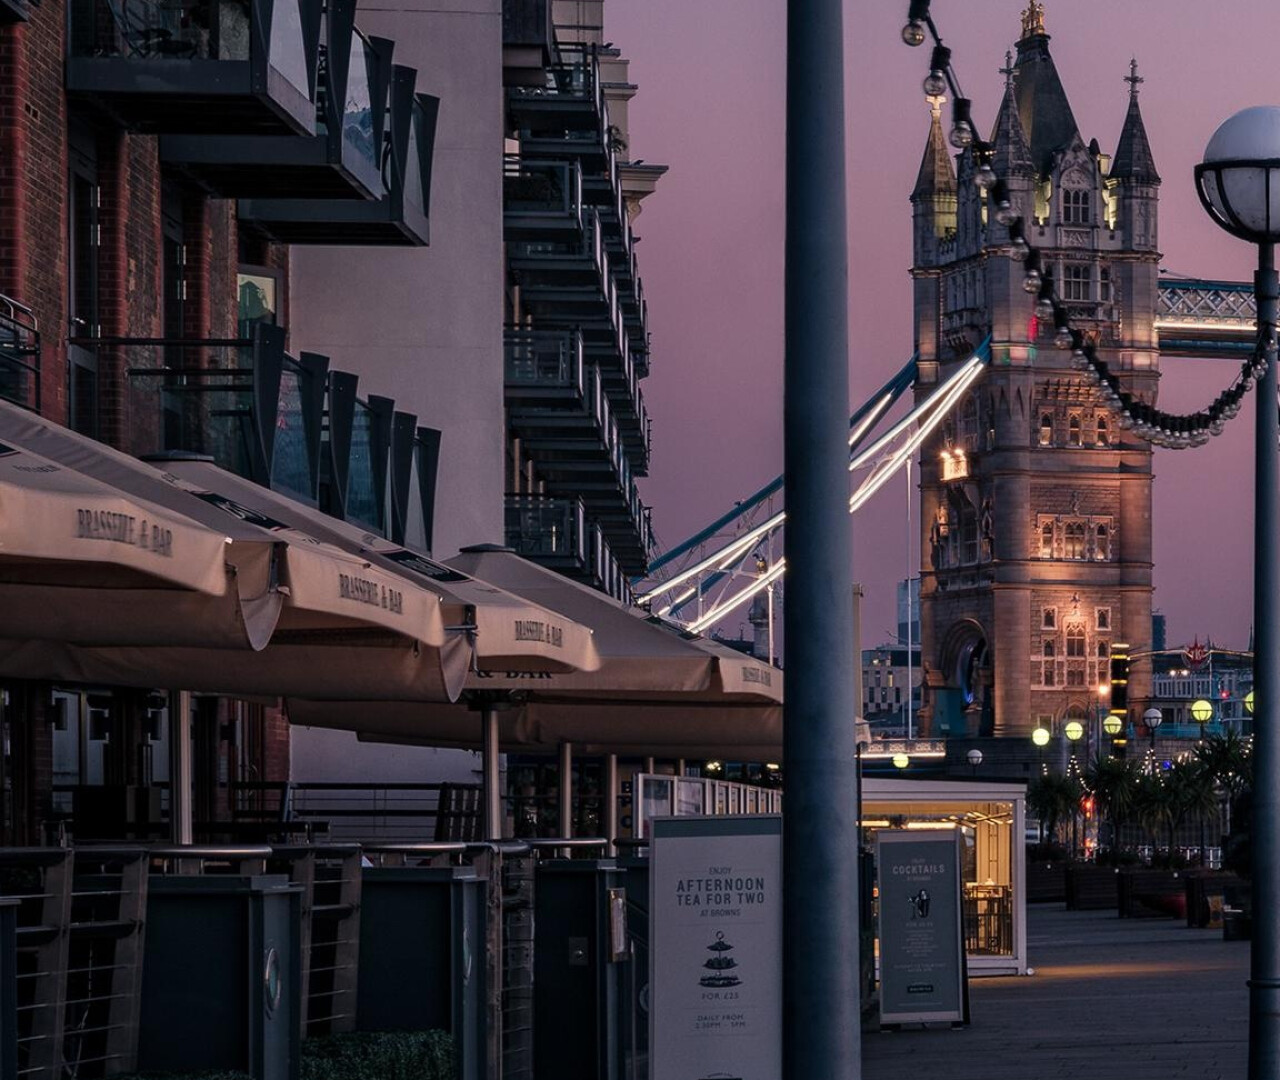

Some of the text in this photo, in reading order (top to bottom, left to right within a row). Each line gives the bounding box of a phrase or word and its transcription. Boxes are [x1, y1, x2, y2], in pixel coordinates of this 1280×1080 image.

[77, 508, 174, 558] BRASSERIE & BAR
[339, 573, 403, 615] BRASSERIE & BAR
[514, 620, 545, 642] BRASSERIE
[551, 626, 562, 648] BAR
[709, 866, 732, 875] ENJOY
[892, 863, 945, 875] COCKTAILS
[676, 877, 765, 893] AFTERNOON
[677, 891, 765, 906] TEA FOR TWO
[700, 908, 741, 918] AT BROWNS
[702, 992, 721, 1001] FOR
[697, 1013, 744, 1022] DAILY FROM
